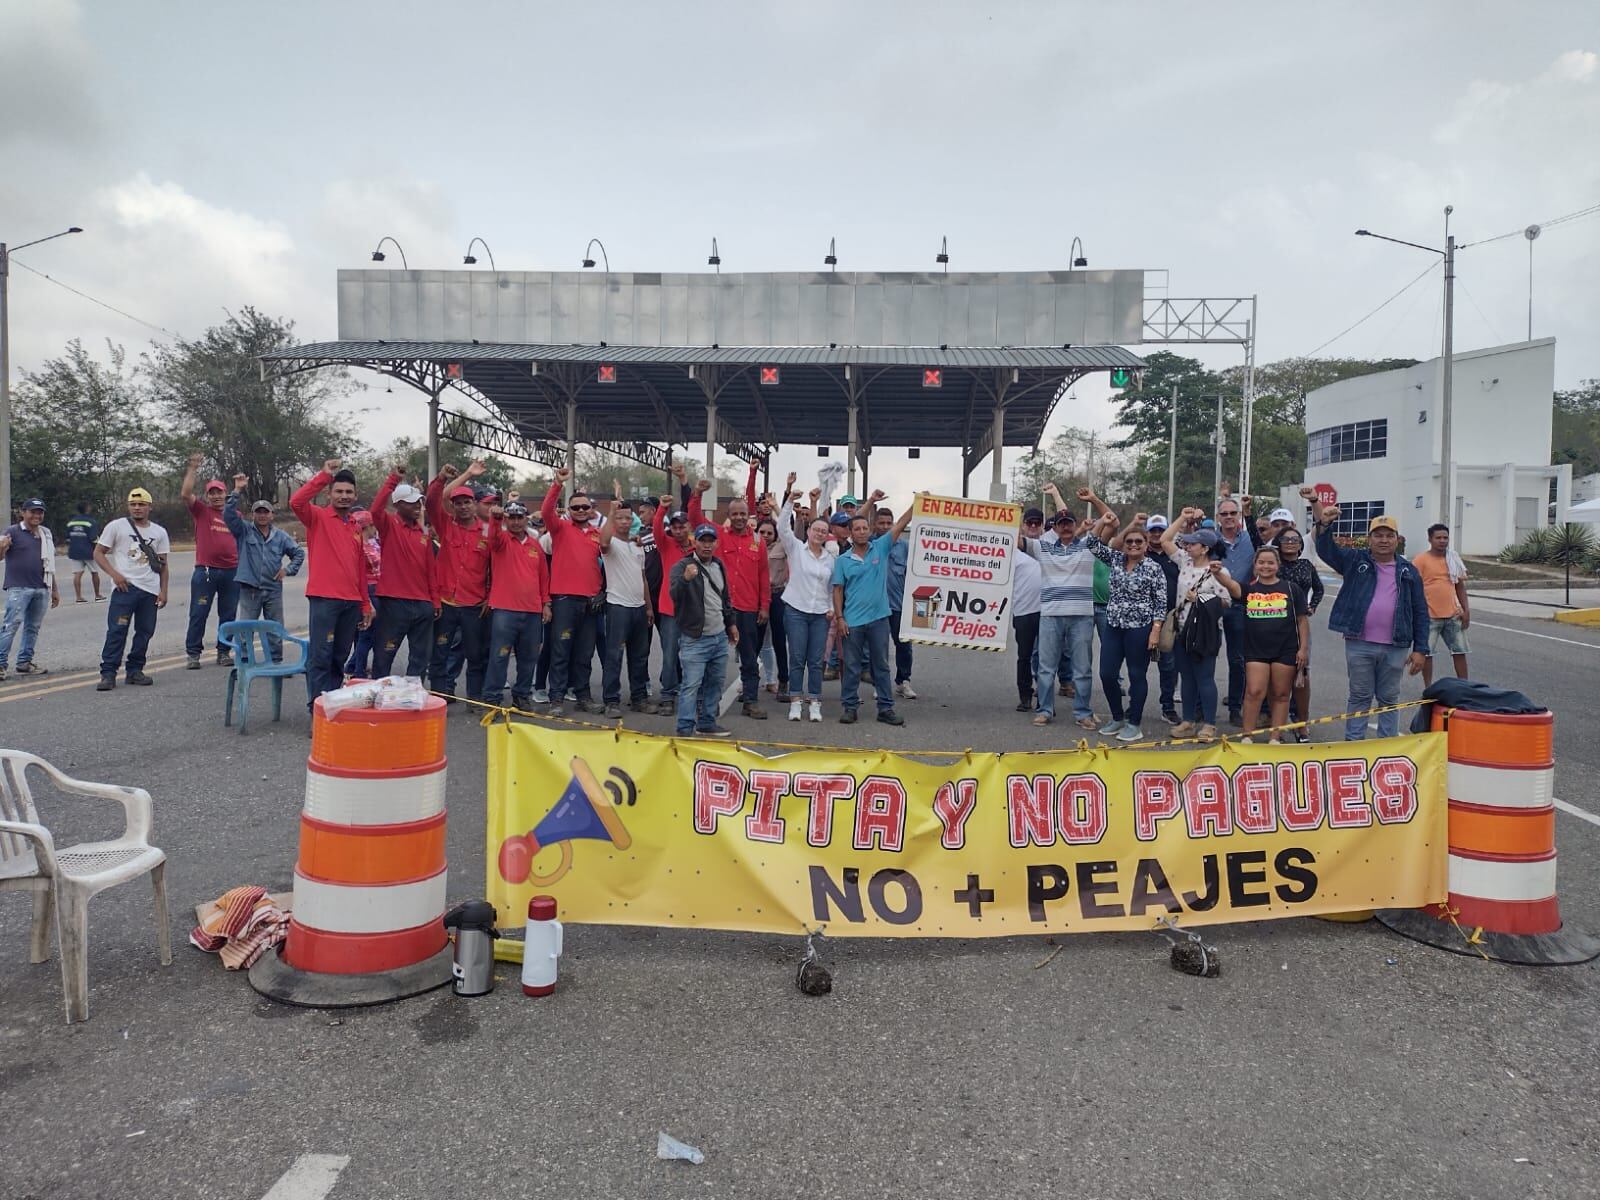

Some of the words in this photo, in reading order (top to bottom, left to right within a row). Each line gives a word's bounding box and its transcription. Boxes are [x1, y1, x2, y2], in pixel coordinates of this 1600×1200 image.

[1317, 491, 1335, 503] ARE
[921, 498, 941, 514] EN
[944, 500, 1014, 523] BALLESTAS
[920, 527, 951, 539] Fuimos
[989, 534, 1000, 545] de
[1001, 536, 1010, 546] la
[921, 538, 1006, 558] VIOLENCIA
[923, 552, 949, 564] Ahora
[988, 559, 1001, 570] del
[929, 565, 993, 581] ESTADO
[941, 615, 997, 641] Peajes
[693, 760, 907, 852] PITA
[932, 778, 978, 850] Y
[1007, 772, 1107, 848] NO
[1133, 756, 1418, 841] PAGUES
[808, 865, 923, 925] NO
[954, 874, 994, 918] +
[1027, 847, 1318, 922] PEAJES
